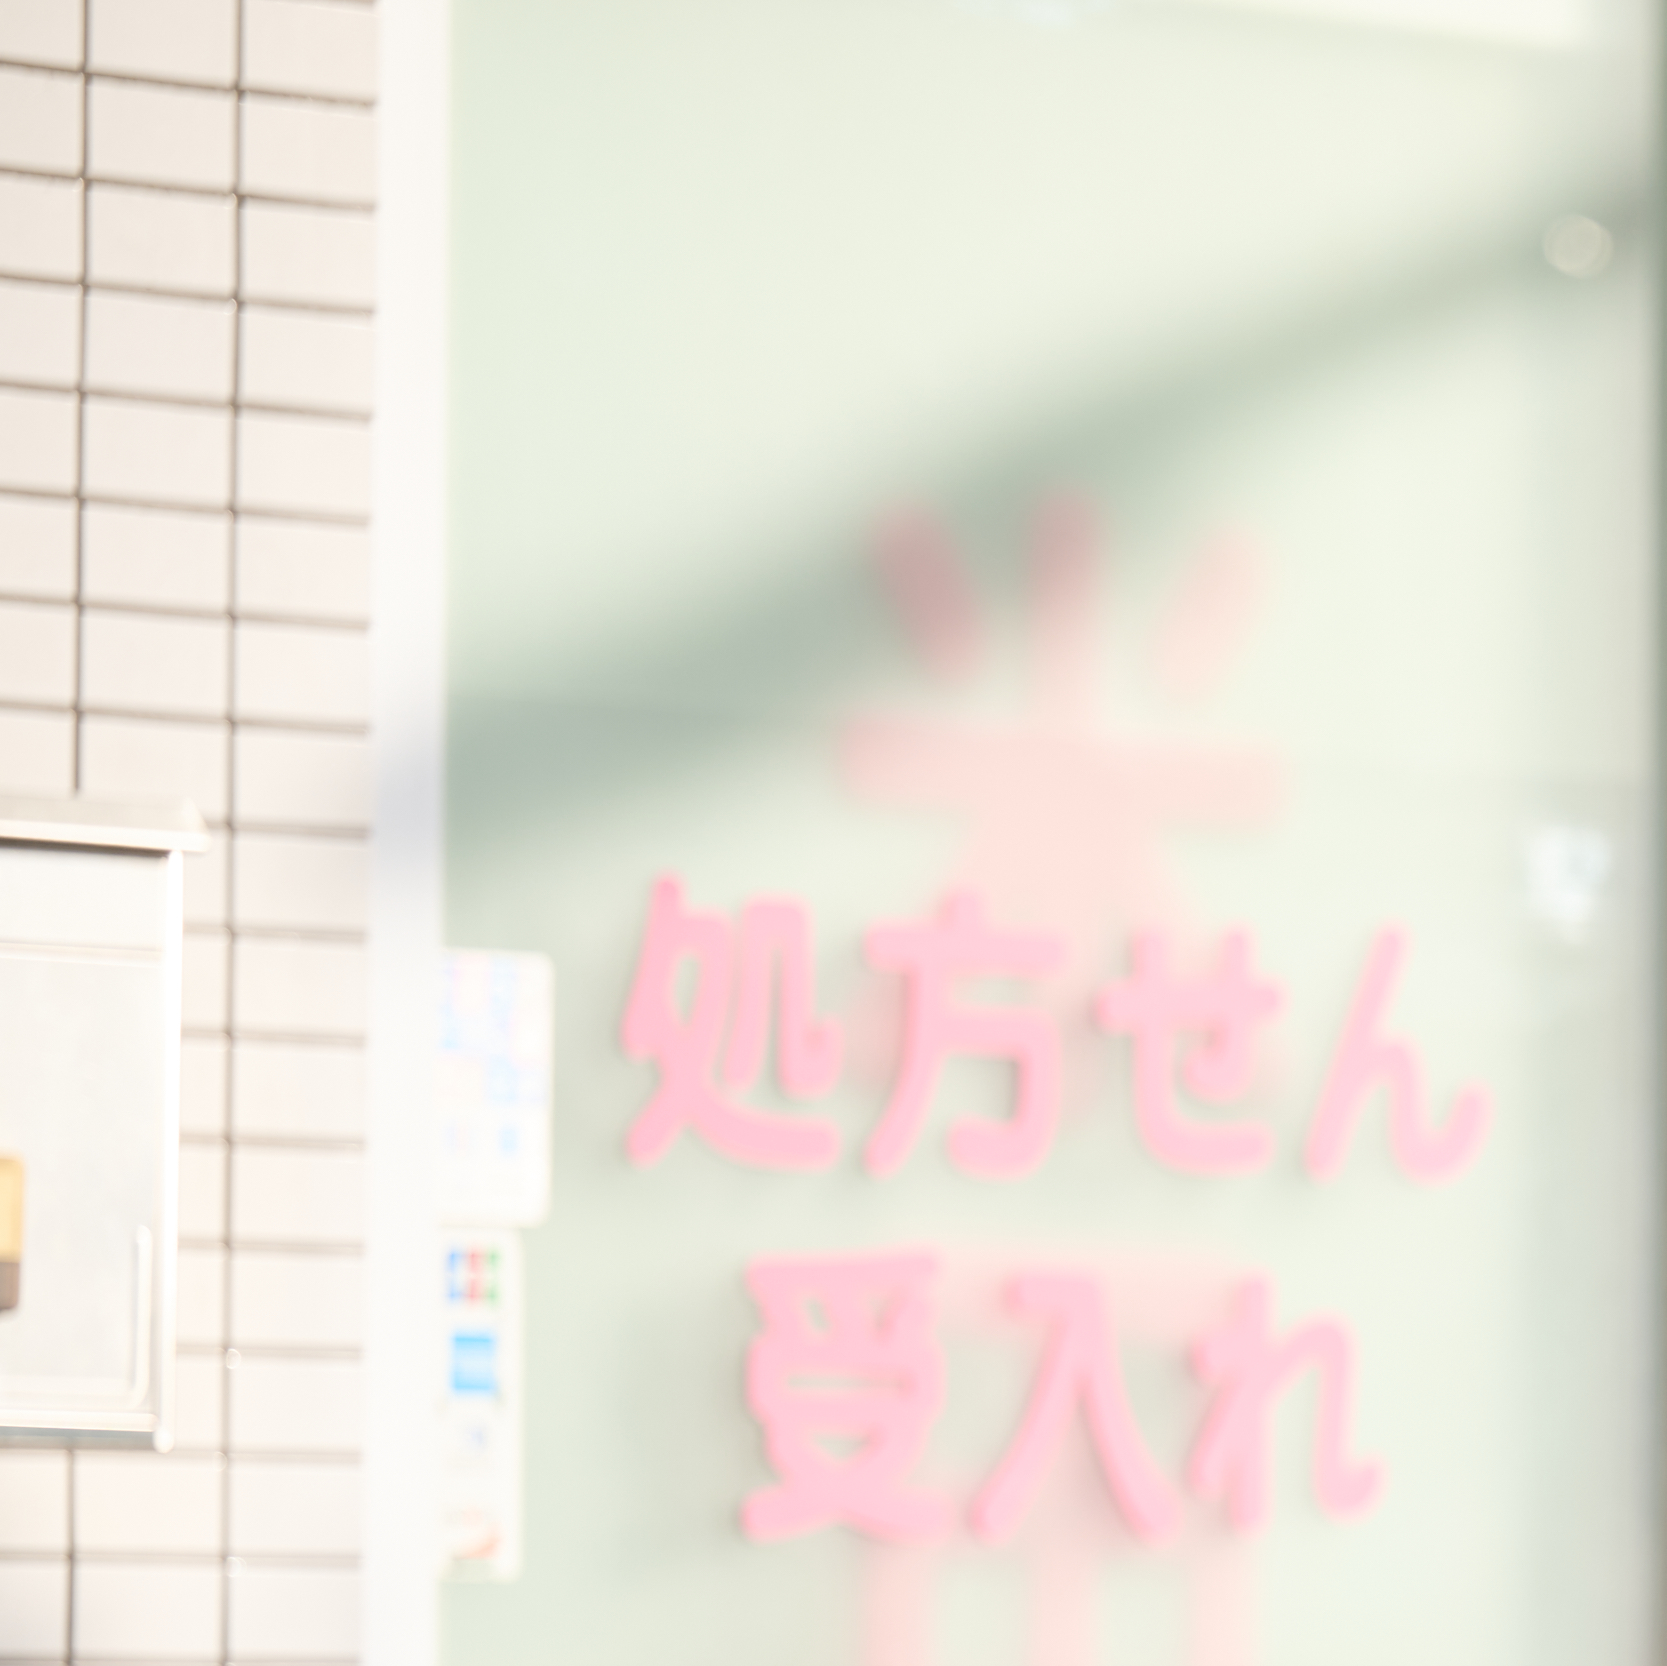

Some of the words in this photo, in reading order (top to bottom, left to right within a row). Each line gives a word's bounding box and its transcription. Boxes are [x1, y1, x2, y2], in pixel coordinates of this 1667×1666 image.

[618, 872, 1497, 1182] 処方せん
[740, 1251, 1386, 1546] 受入れ
